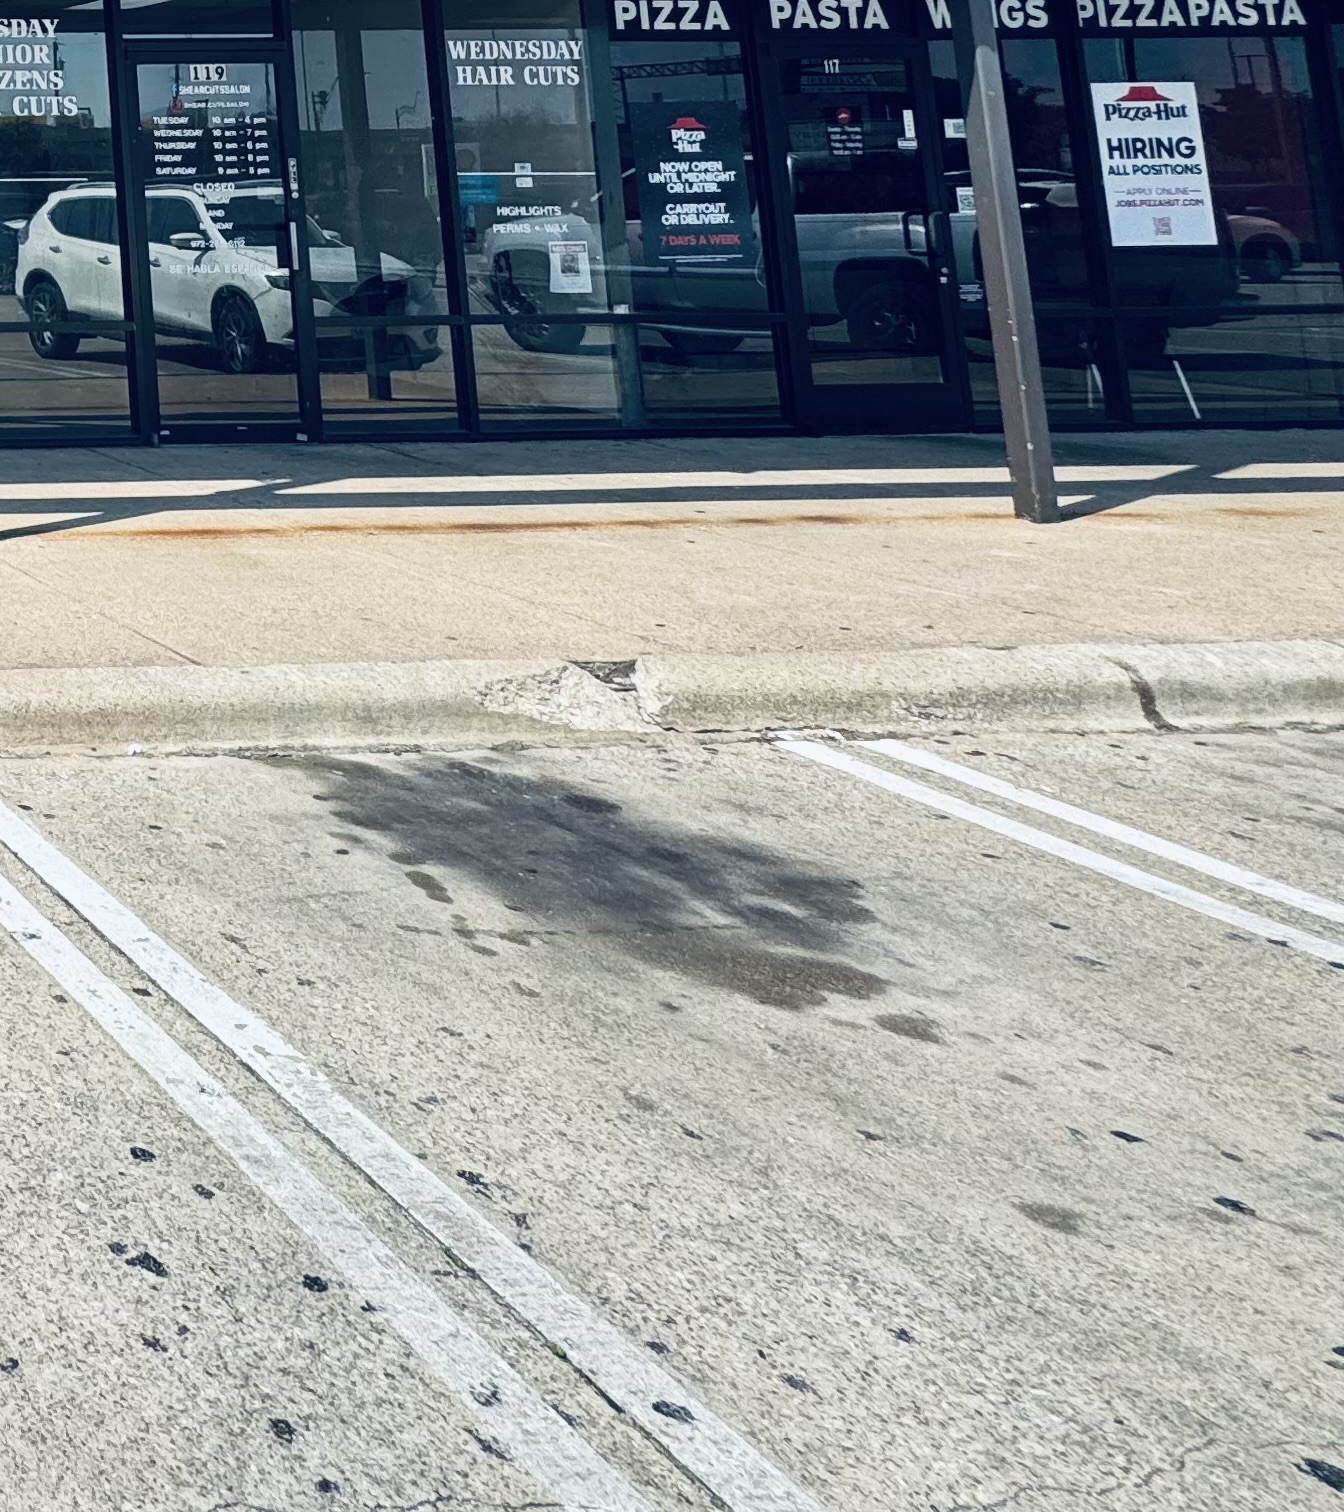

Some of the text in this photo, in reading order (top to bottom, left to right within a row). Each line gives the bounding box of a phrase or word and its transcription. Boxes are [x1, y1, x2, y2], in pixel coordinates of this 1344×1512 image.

[614, 0, 730, 30] PIZZA
[447, 39, 583, 61] WEDNESDAY
[192, 65, 225, 81] 119
[823, 59, 840, 74] 117
[456, 65, 580, 87] HAIR CUTS
[12, 95, 78, 117] CUTS
[1103, 102, 1189, 122] Pizza Hut
[671, 129, 706, 142] Pizza
[1106, 137, 1197, 160] HIRING
[659, 161, 723, 173] NOW OPEN
[1108, 163, 1203, 176] ALL POSITIONS
[648, 171, 737, 184] UNTIL MIDNIGHT
[666, 183, 684, 194] OR
[496, 206, 562, 216] HIGHLIGHTS
[665, 203, 727, 215] CARRYOUT
[661, 215, 680, 226] OR
[492, 223, 531, 234] PERMS
[669, 235, 697, 246] DAYS
[709, 234, 741, 246] WEEK
